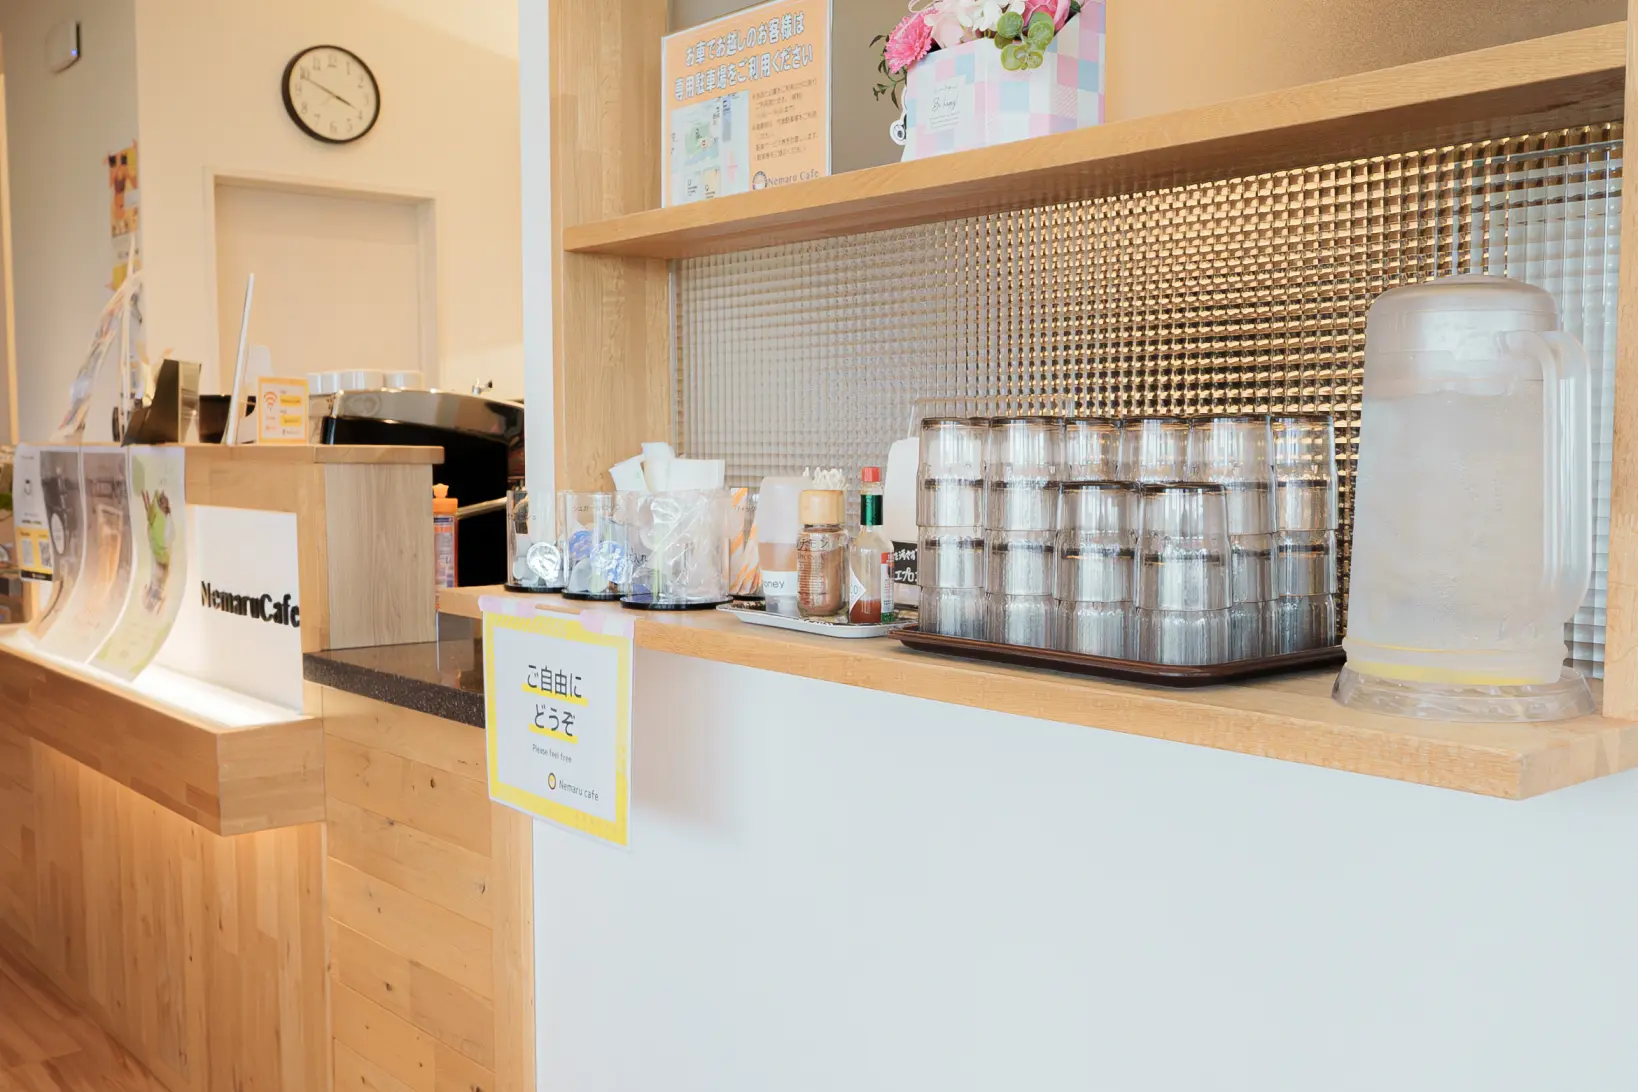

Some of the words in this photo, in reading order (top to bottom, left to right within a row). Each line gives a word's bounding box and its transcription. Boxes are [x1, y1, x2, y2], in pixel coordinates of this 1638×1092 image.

[685, 11, 805, 66] お車でお越しのお客様は
[674, 44, 814, 101] 専用駐車場をご利用ください
[768, 173, 797, 187] Nemaru
[799, 168, 819, 182] Cafe
[527, 664, 582, 698] ご自由に
[534, 704, 575, 737] どうぞ
[532, 744, 548, 756] Please
[549, 748, 559, 759] feel
[560, 753, 572, 763] free
[559, 780, 583, 796] Nemaru
[584, 789, 599, 801] cafe
